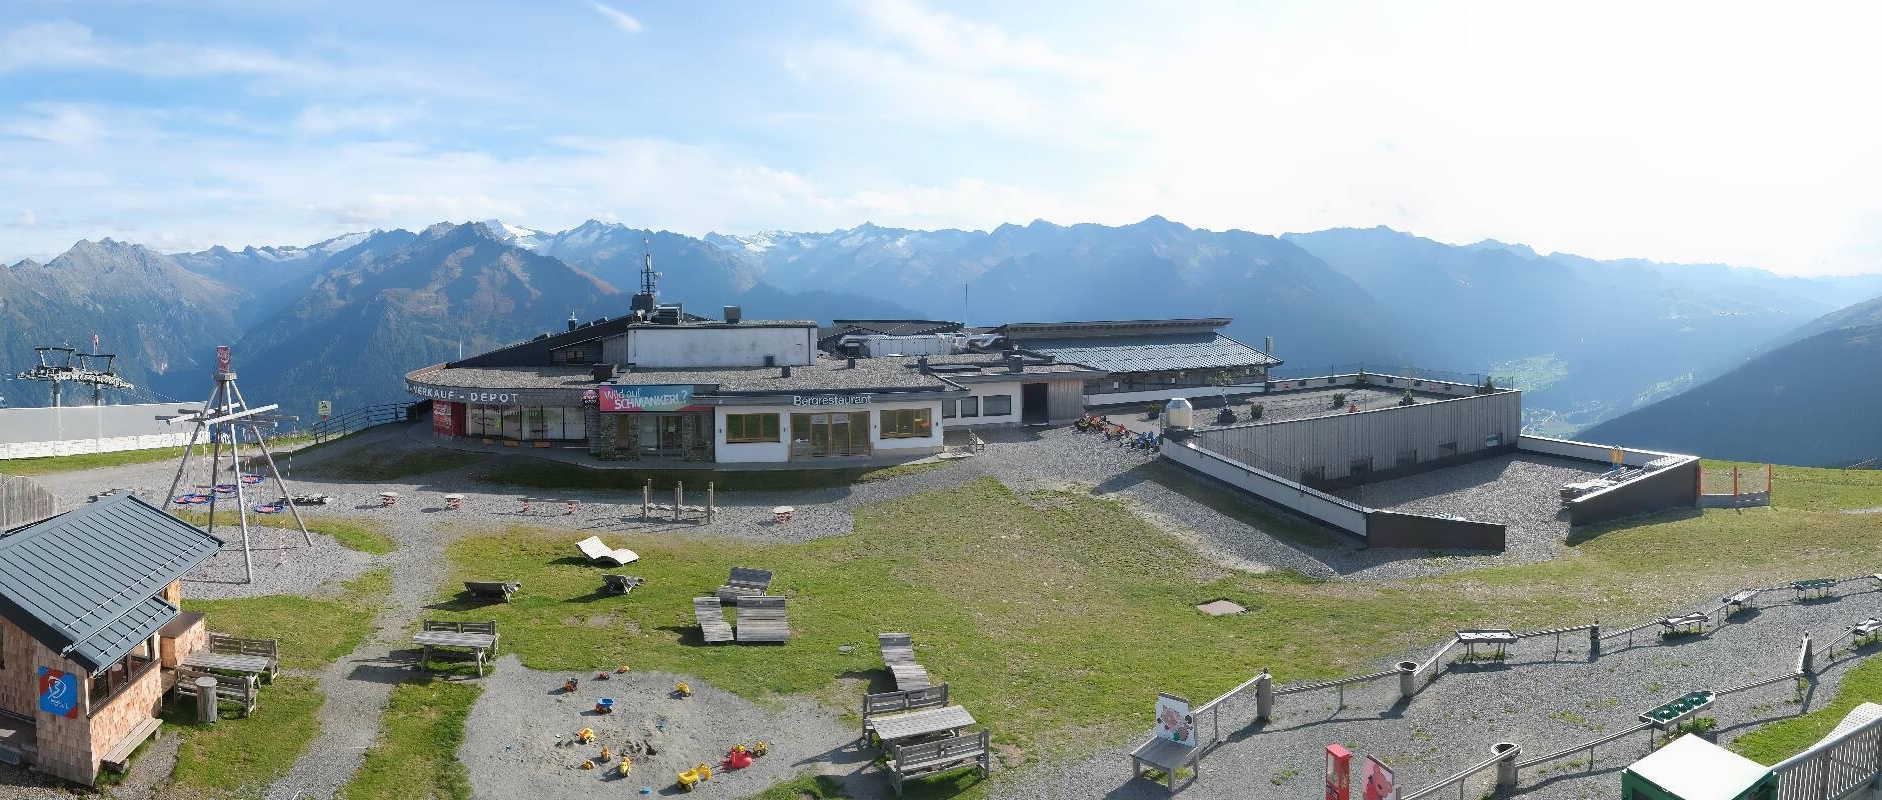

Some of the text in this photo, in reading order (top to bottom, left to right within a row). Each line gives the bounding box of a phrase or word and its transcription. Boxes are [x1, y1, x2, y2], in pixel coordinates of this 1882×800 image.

[414, 386, 454, 400] VERKAUF
[470, 392, 519, 403] DEPOT
[604, 387, 642, 400] Wild auf
[794, 394, 872, 407] Bergrestaurant
